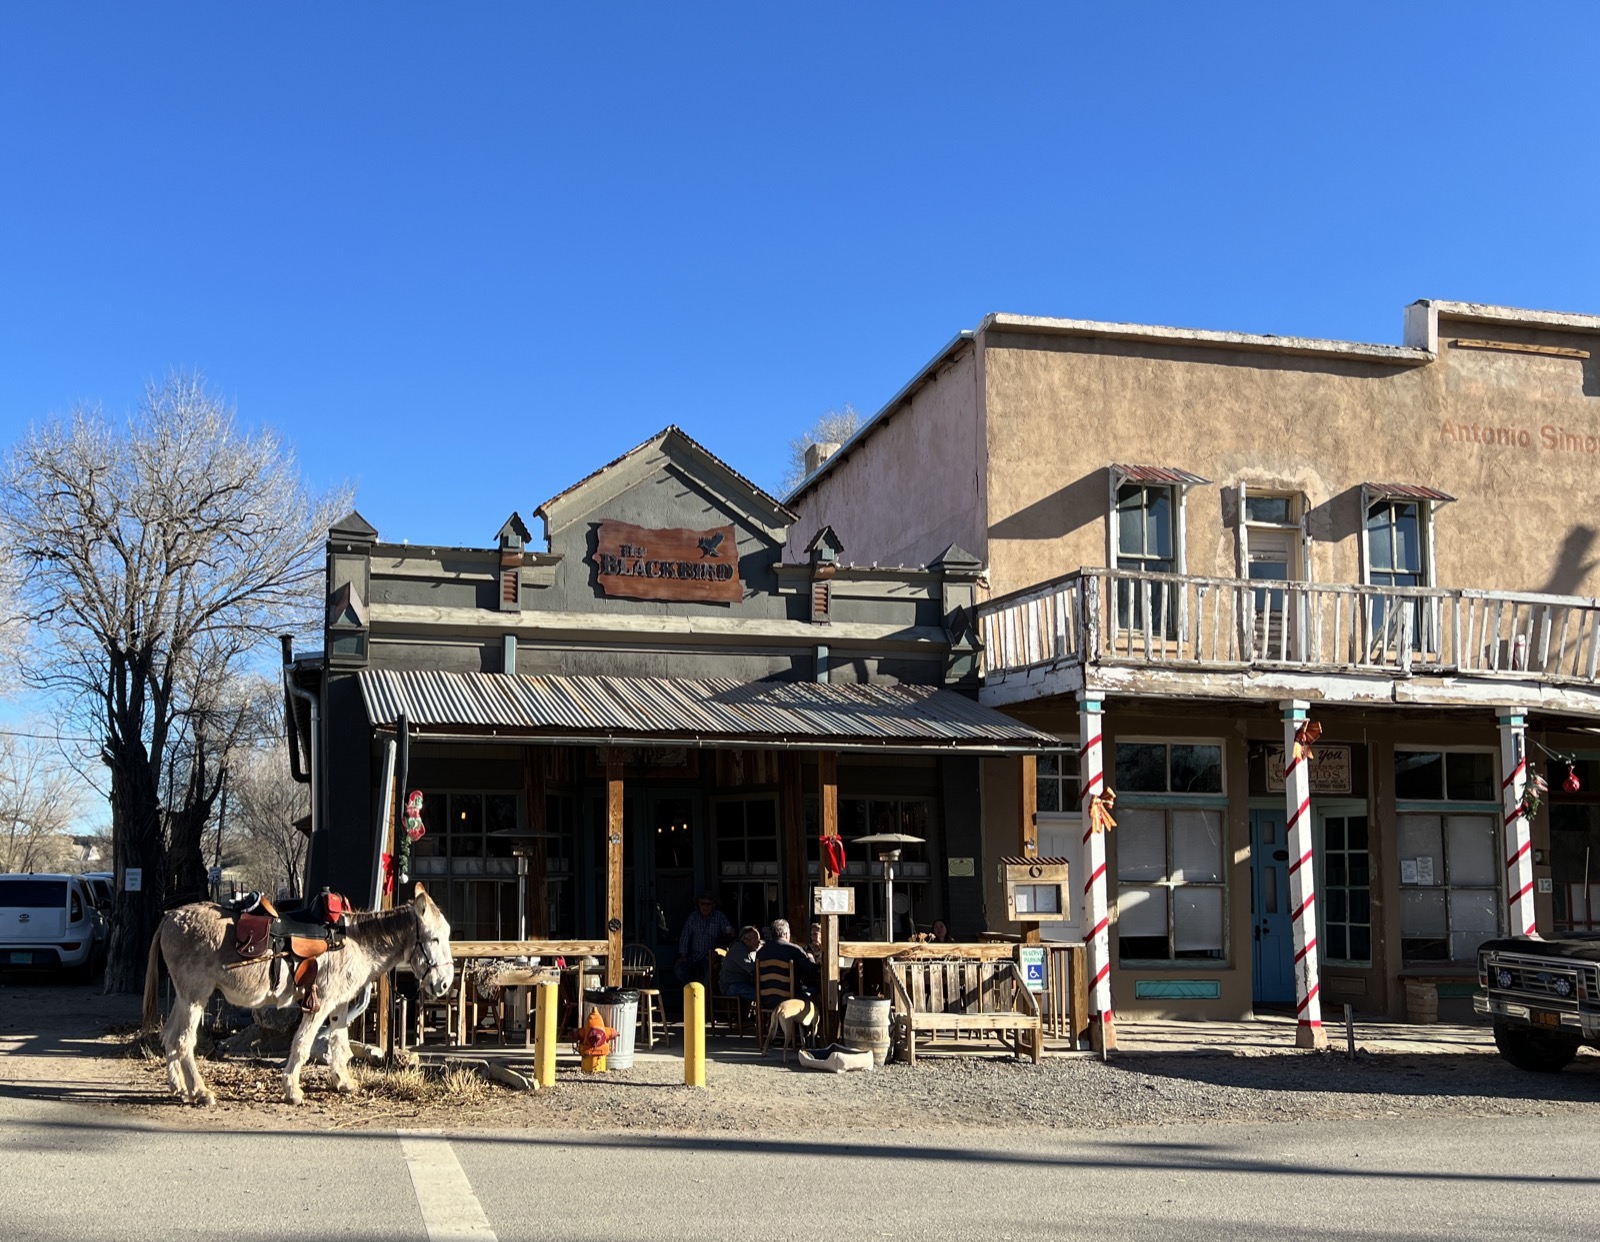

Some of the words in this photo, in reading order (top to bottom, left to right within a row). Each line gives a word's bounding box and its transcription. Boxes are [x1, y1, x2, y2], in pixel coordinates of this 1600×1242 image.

[1439, 418, 1530, 448] Antonio
[1540, 423, 1600, 454] Simo
[600, 553, 733, 581] BLACKBIRD
[1318, 749, 1342, 764] You
[1540, 879, 1551, 891] 13
